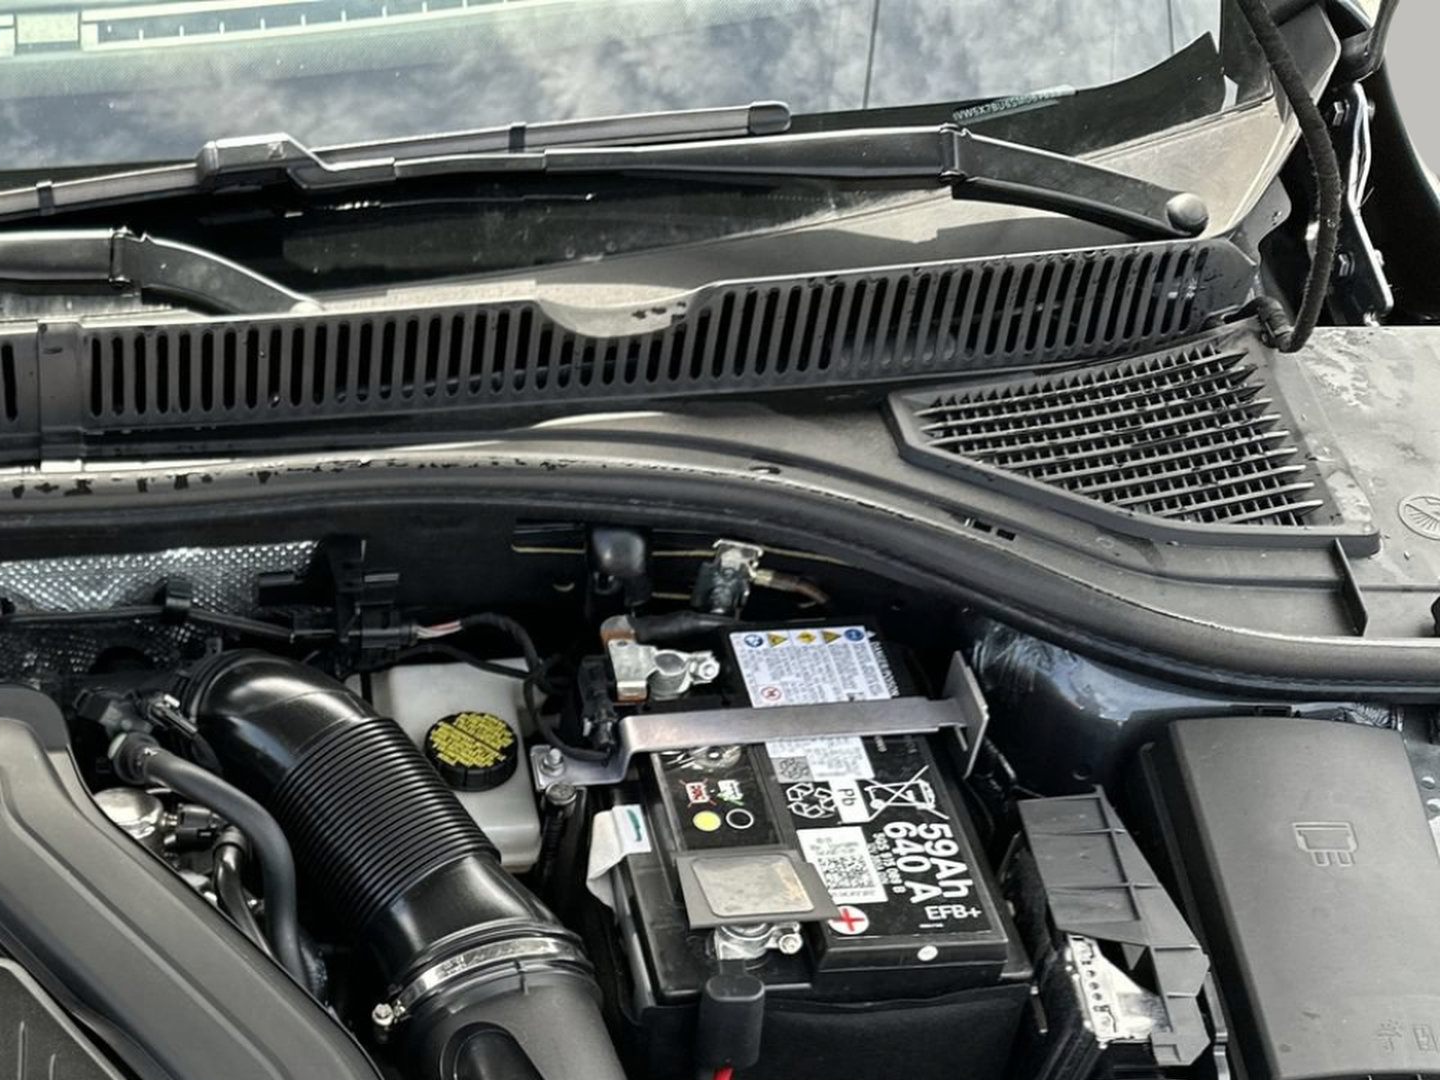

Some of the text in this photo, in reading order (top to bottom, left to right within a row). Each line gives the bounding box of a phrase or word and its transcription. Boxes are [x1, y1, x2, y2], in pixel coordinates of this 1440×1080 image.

[836, 787, 856, 807] Pb
[883, 821, 943, 904] 640 A
[918, 823, 974, 898] 59Ah
[924, 903, 982, 921] EFB+
